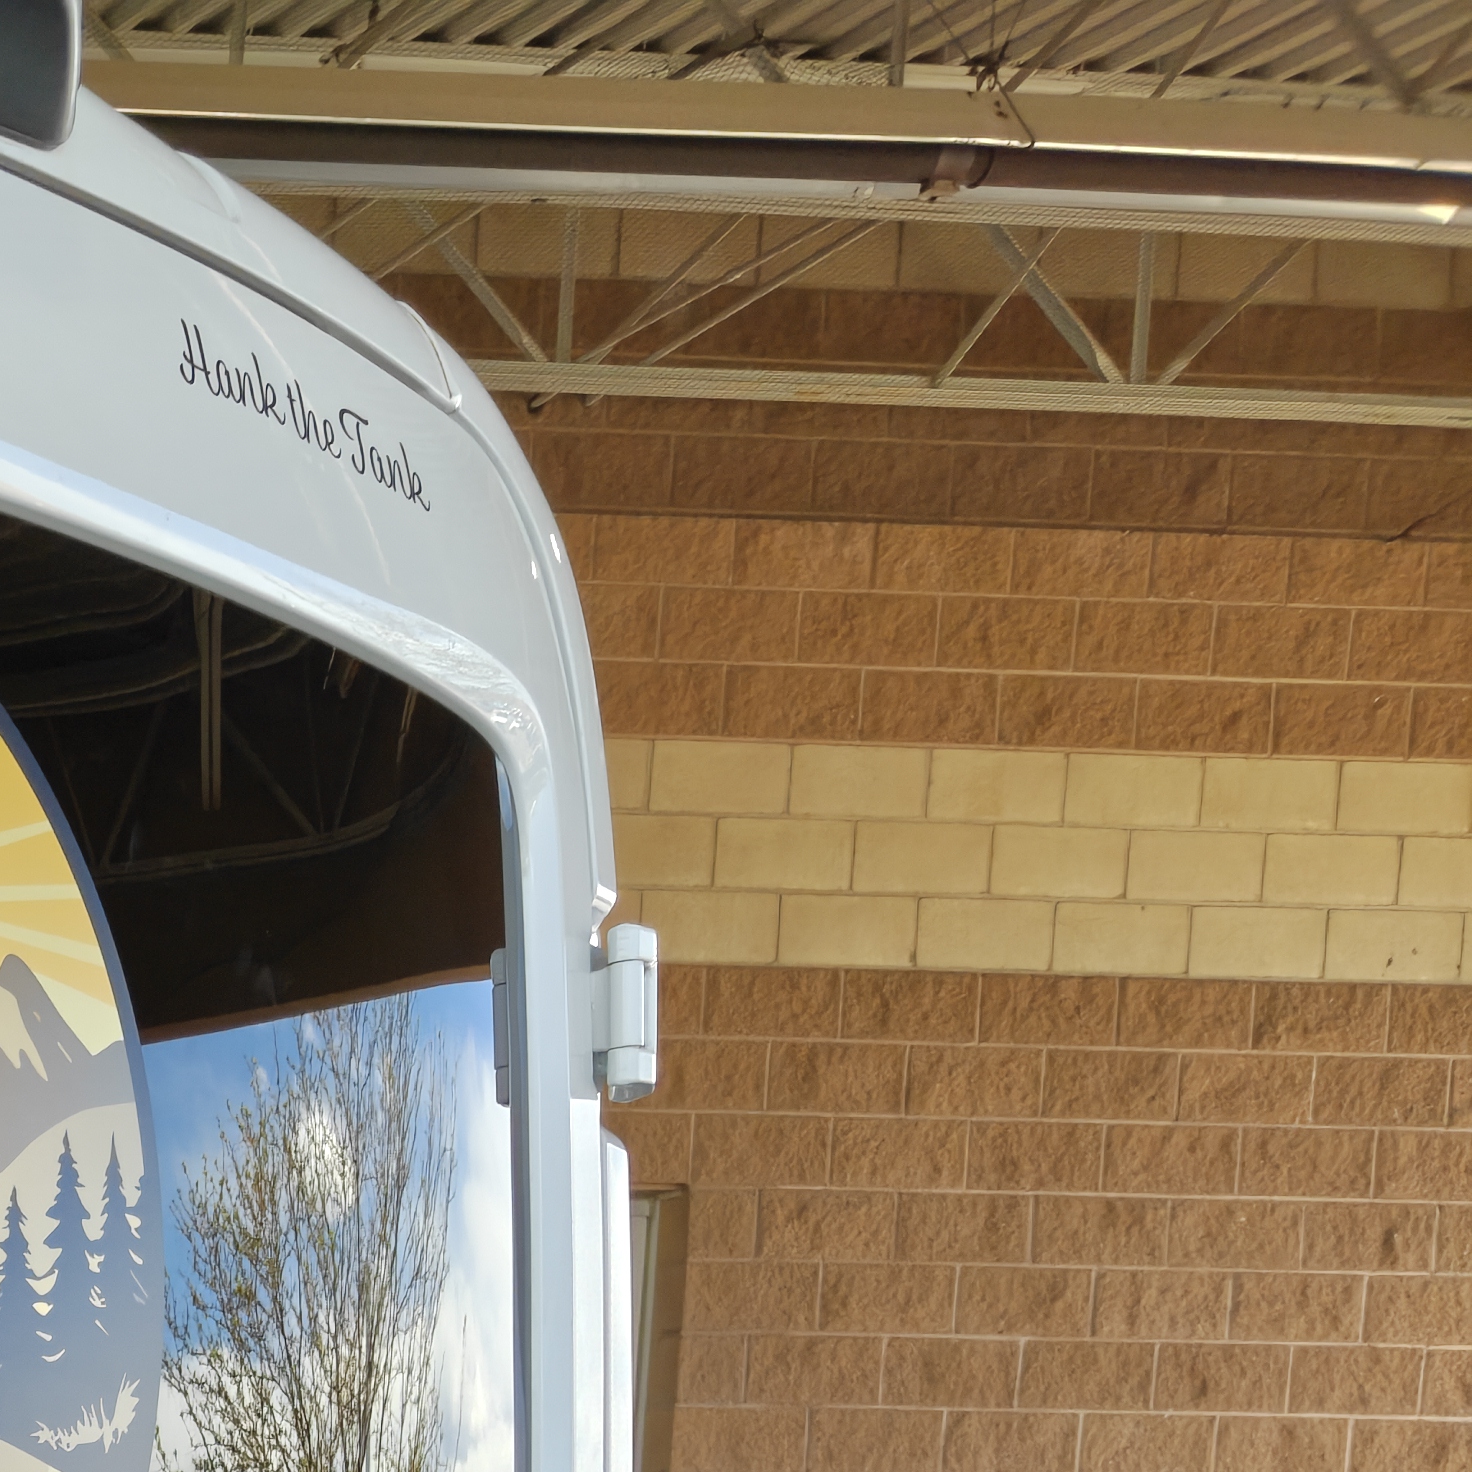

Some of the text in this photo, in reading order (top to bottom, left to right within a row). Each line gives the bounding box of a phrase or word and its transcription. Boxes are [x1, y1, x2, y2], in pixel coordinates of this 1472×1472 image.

[179, 317, 431, 512] Hank the Tank
